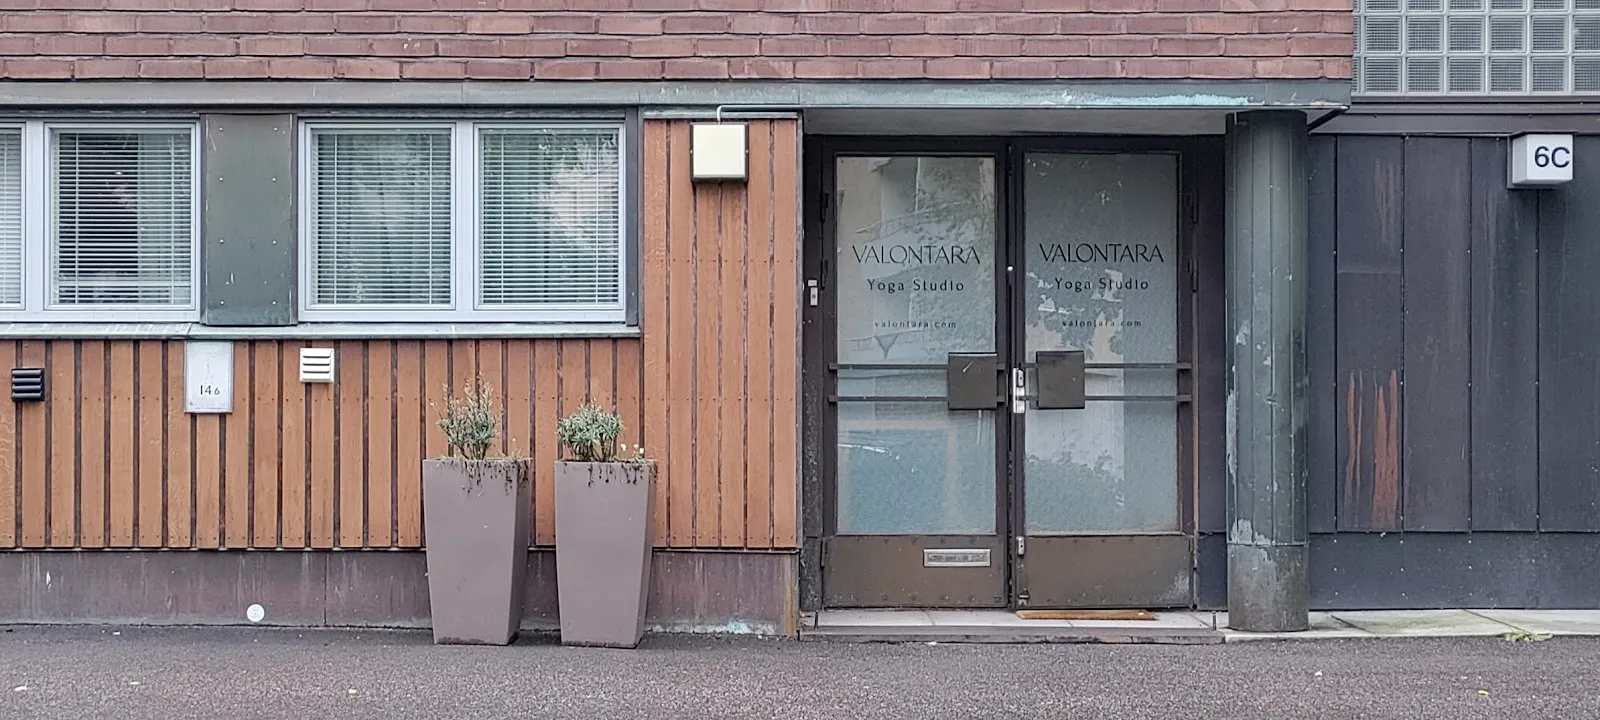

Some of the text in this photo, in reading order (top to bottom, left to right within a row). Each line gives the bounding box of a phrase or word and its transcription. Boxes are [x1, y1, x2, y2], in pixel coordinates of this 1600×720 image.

[1534, 146, 1570, 168] 6C
[852, 245, 980, 264] VALONTARA
[1039, 243, 1164, 262] VALONTARA
[867, 279, 964, 293] Yoga Studio
[1055, 277, 1149, 292] Yoga Studio
